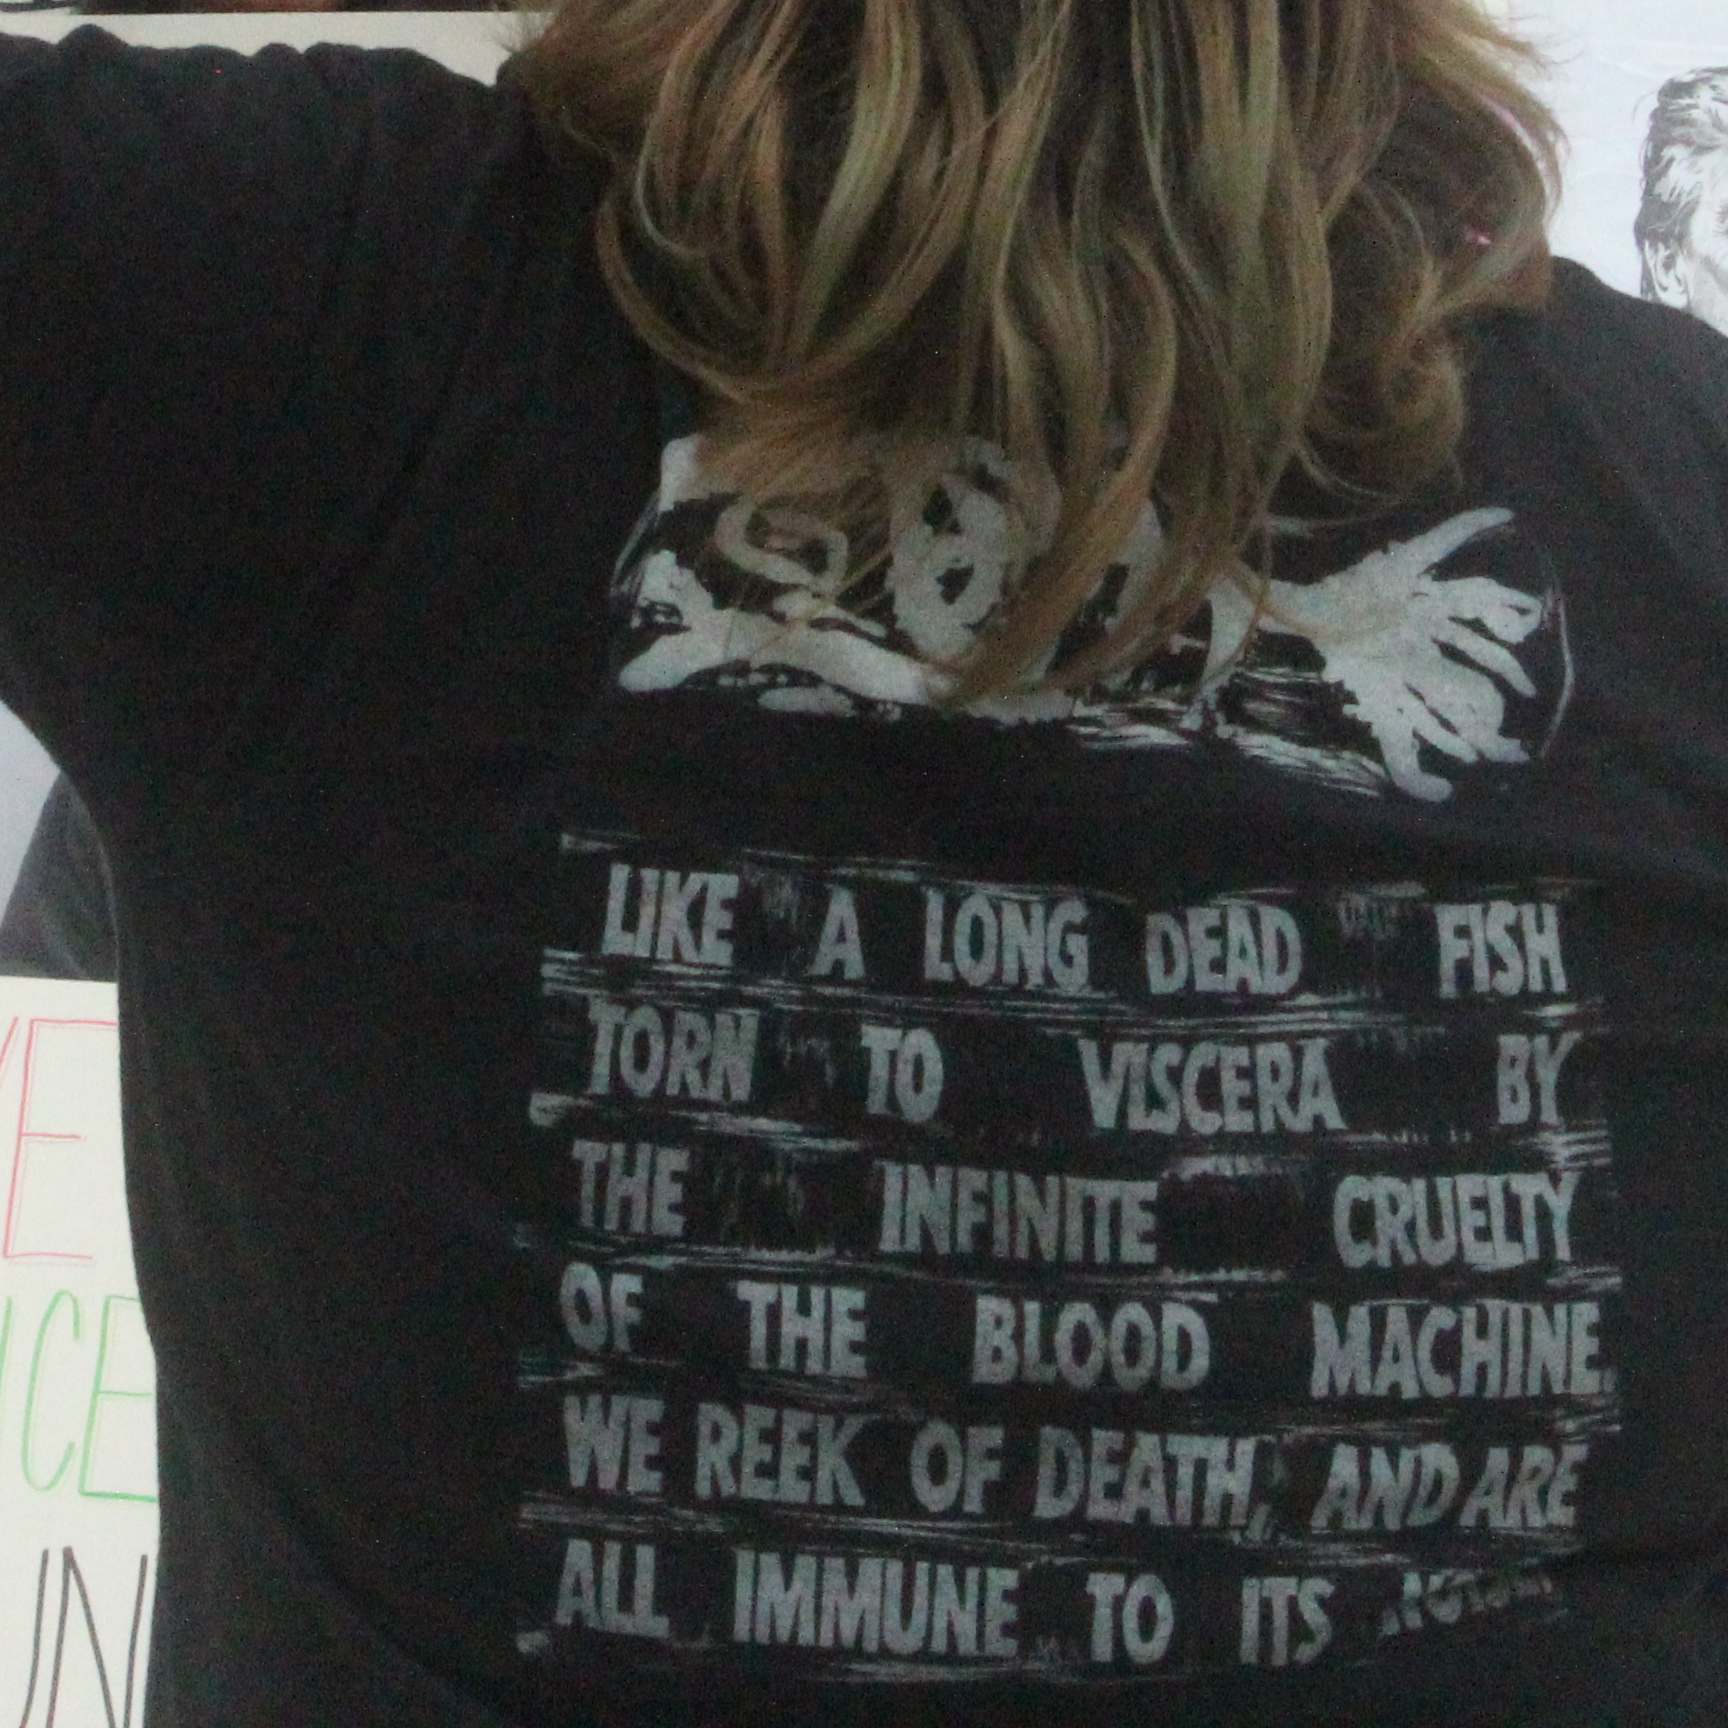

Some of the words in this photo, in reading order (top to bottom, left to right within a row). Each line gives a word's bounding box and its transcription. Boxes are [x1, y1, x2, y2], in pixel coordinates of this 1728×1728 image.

[601, 864, 740, 969] LIKE
[810, 889, 867, 982] A
[922, 887, 1090, 994] LONG
[1144, 904, 1303, 1000] DEAD
[1435, 901, 1569, 1000] FISH
[587, 998, 758, 1104] TORN
[861, 1026, 944, 1125] TO
[1076, 1037, 1345, 1137] VISCERA
[1496, 1032, 1583, 1127] BY
[571, 1139, 689, 1239] THE
[876, 1160, 1159, 1266] INFINITE
[1332, 1173, 1579, 1271] CRUELTY
[559, 1264, 644, 1355] OF
[736, 1279, 870, 1383] THE
[970, 1294, 1211, 1388] BLOOD
[561, 1394, 664, 1498] WE
[695, 1404, 867, 1510] REEK
[909, 1419, 1004, 1516] OF
[1312, 1444, 1462, 1533] AND
[1470, 1443, 1582, 1530] ARE
[556, 1538, 671, 1640] ALL
[732, 1548, 1020, 1659] IMMUNE
[1086, 1571, 1176, 1665] TO
[1239, 1576, 1336, 1666] ITS
